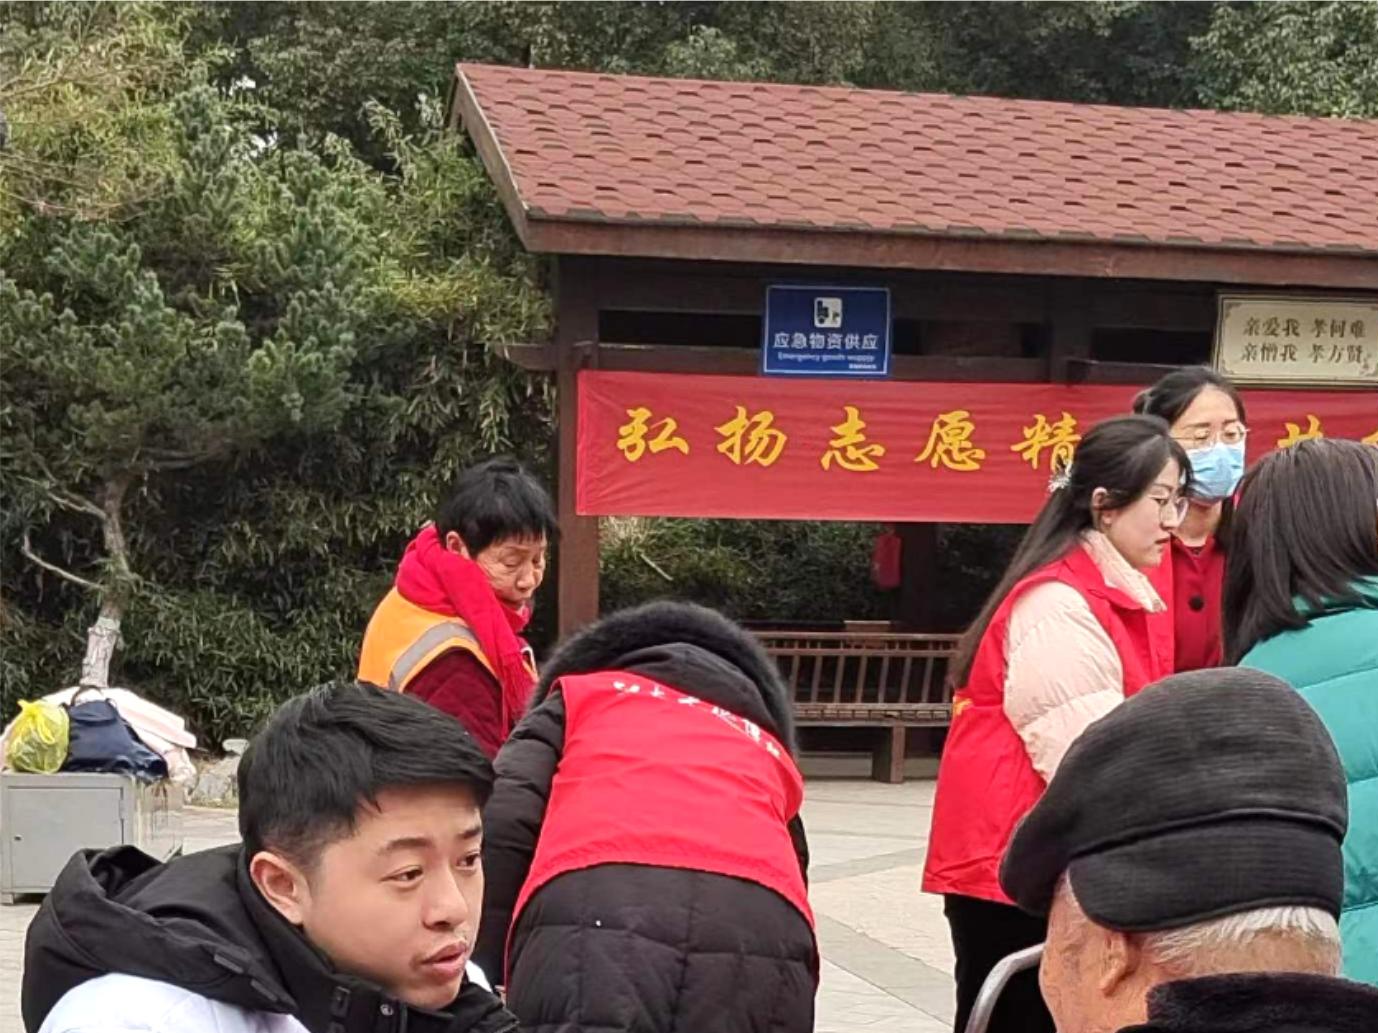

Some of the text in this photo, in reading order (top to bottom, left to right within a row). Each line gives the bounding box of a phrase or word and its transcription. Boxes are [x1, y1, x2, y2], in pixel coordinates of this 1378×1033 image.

[773, 332, 879, 350] 应急物资供应
